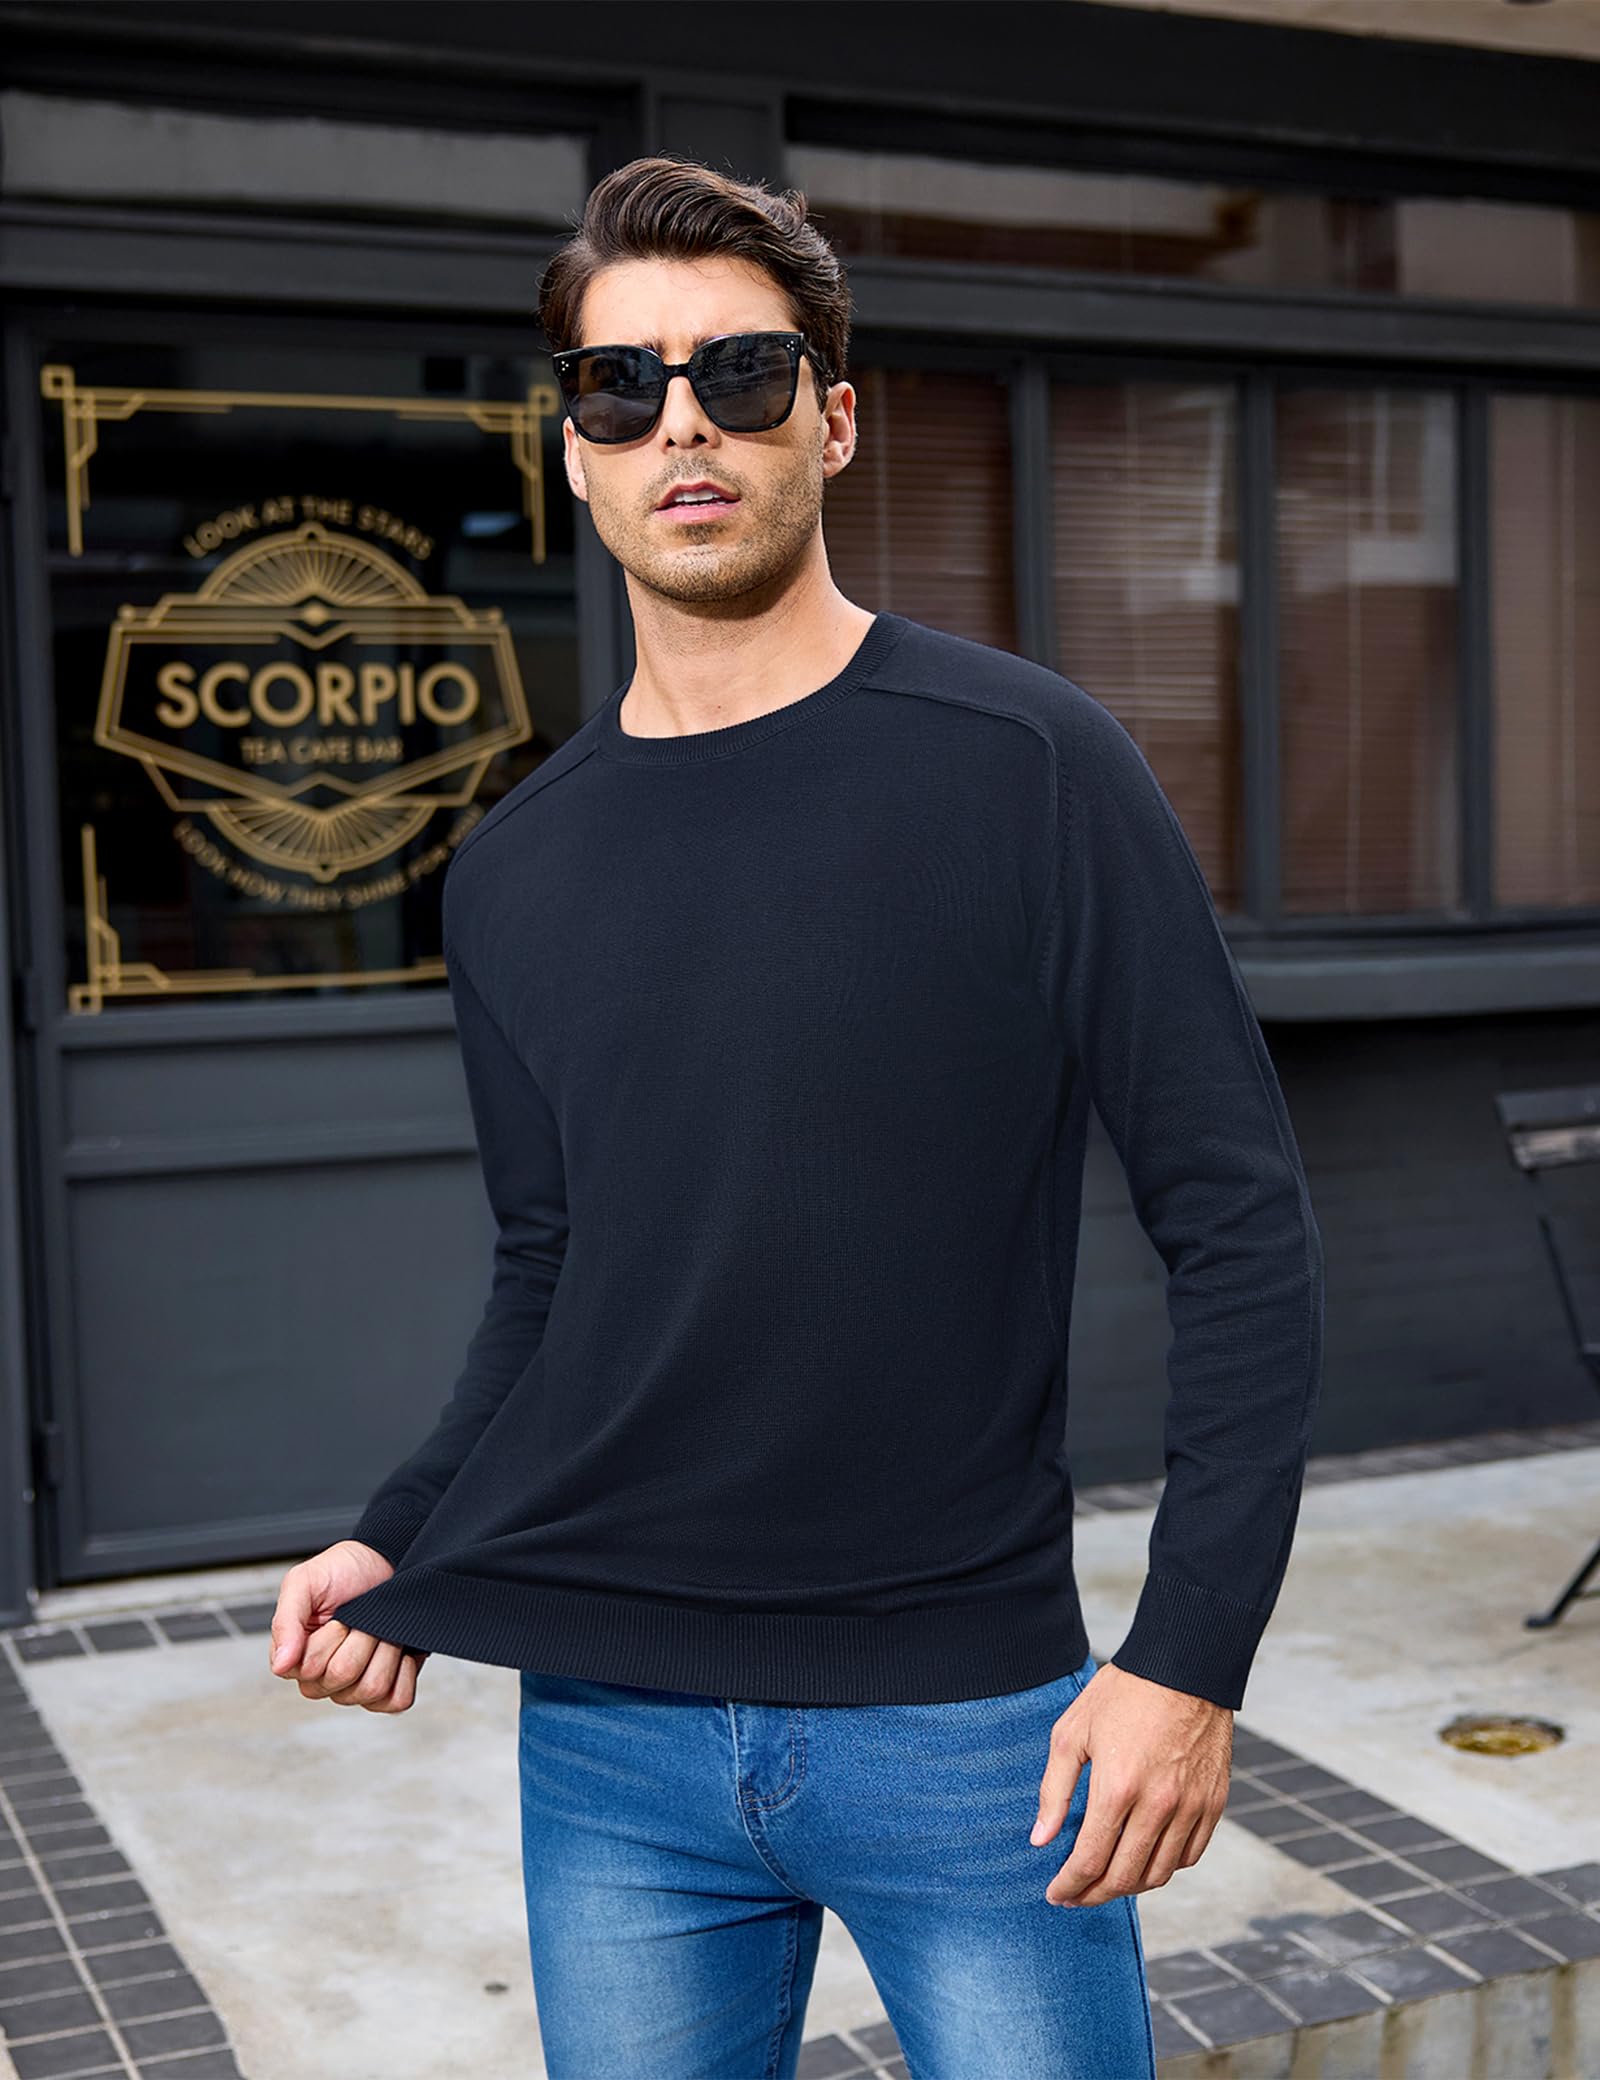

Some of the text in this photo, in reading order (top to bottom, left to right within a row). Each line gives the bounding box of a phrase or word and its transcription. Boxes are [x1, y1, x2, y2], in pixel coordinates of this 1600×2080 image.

[182, 496, 433, 560] LOOK AT THE STARS
[156, 661, 479, 728] SCORPIO
[241, 737, 287, 764] TEA
[354, 736, 403, 763] BAR
